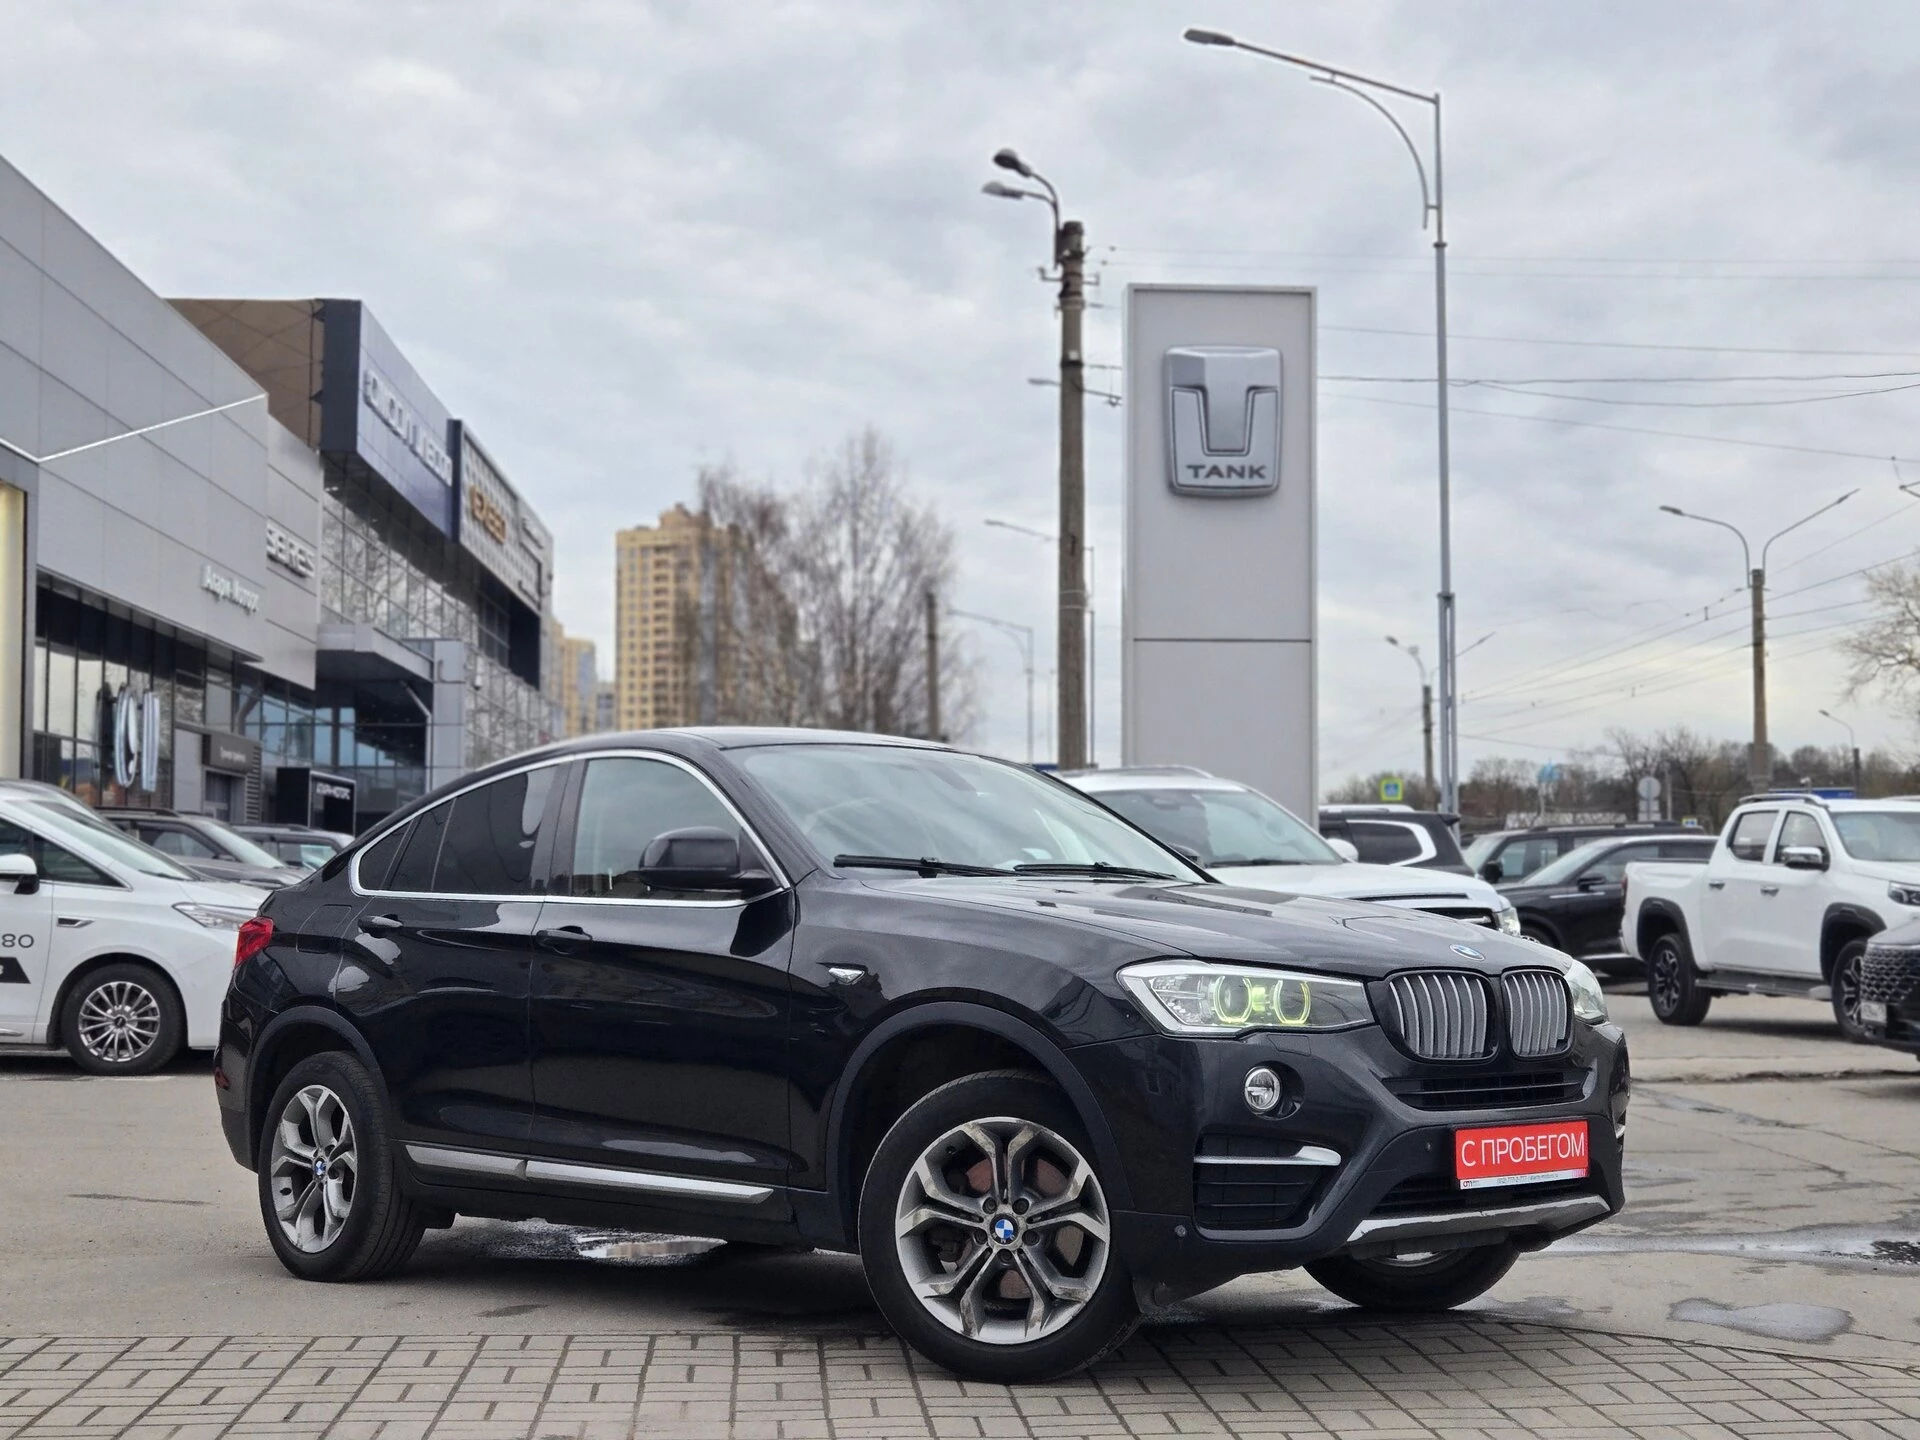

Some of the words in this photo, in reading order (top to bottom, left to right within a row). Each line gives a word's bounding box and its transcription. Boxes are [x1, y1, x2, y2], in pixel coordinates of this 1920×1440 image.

[1186, 464, 1267, 479] TANK
[1461, 1140, 1476, 1167] С
[1481, 1132, 1585, 1166] ПРОБЕГОМ
